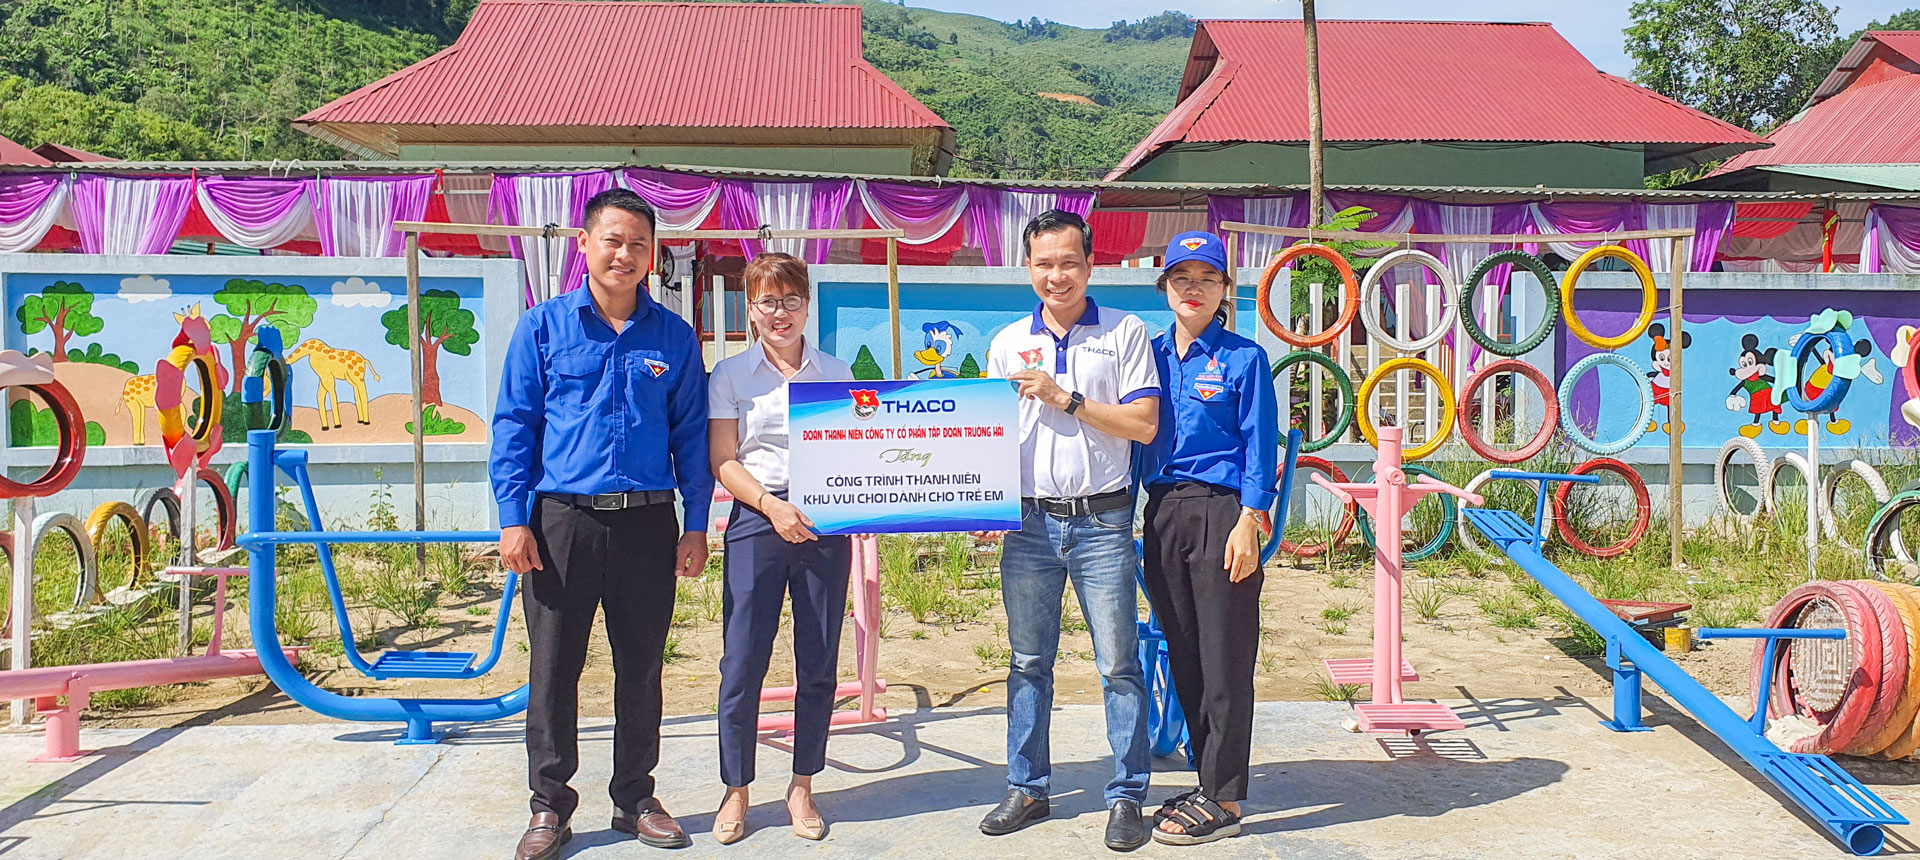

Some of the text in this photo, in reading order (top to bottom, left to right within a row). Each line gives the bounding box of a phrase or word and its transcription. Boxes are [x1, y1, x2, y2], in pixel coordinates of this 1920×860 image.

[1082, 346, 1116, 357] THACO
[881, 399, 956, 413] THACO
[824, 429, 847, 441] THANH
[886, 428, 895, 440] TY
[905, 474, 950, 486] THANH
[803, 494, 831, 505] KHU
[832, 493, 855, 504] VUI
[928, 491, 955, 503] CHO
[984, 490, 1004, 501] EM
